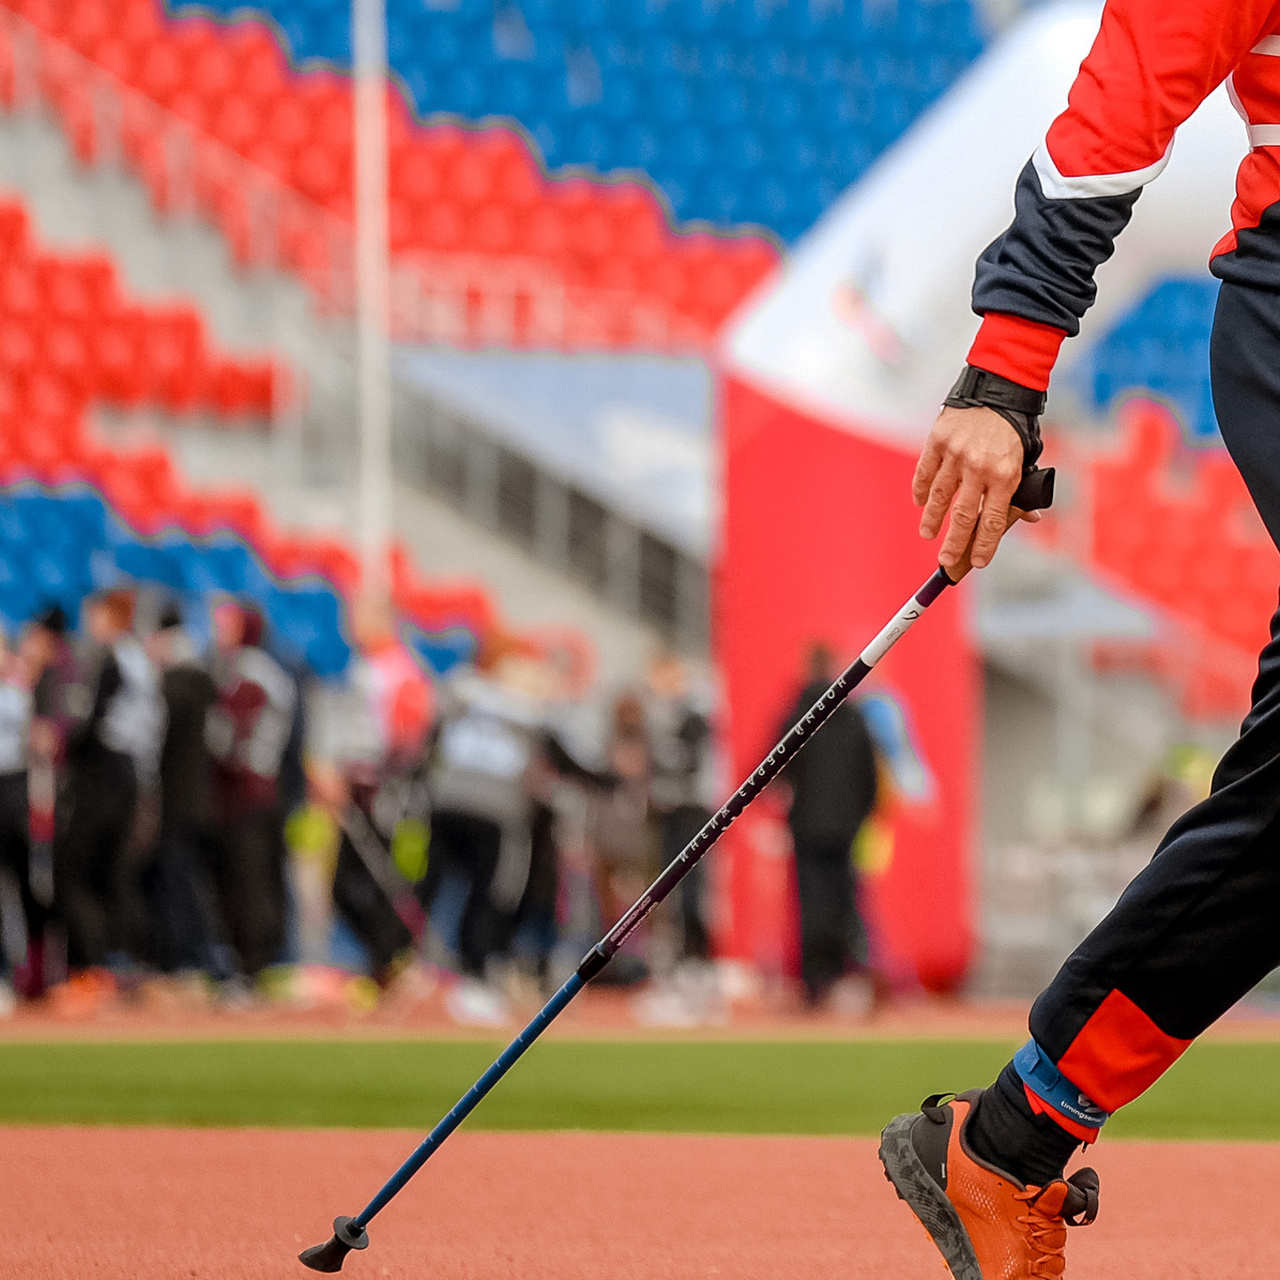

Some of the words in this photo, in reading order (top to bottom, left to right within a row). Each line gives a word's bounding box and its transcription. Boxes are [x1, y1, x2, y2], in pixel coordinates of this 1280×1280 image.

[794, 677, 847, 736] НОВЫЙ
[739, 743, 786, 797] ОБРАЗ
[680, 806, 730, 863] ЖИЗНИ
